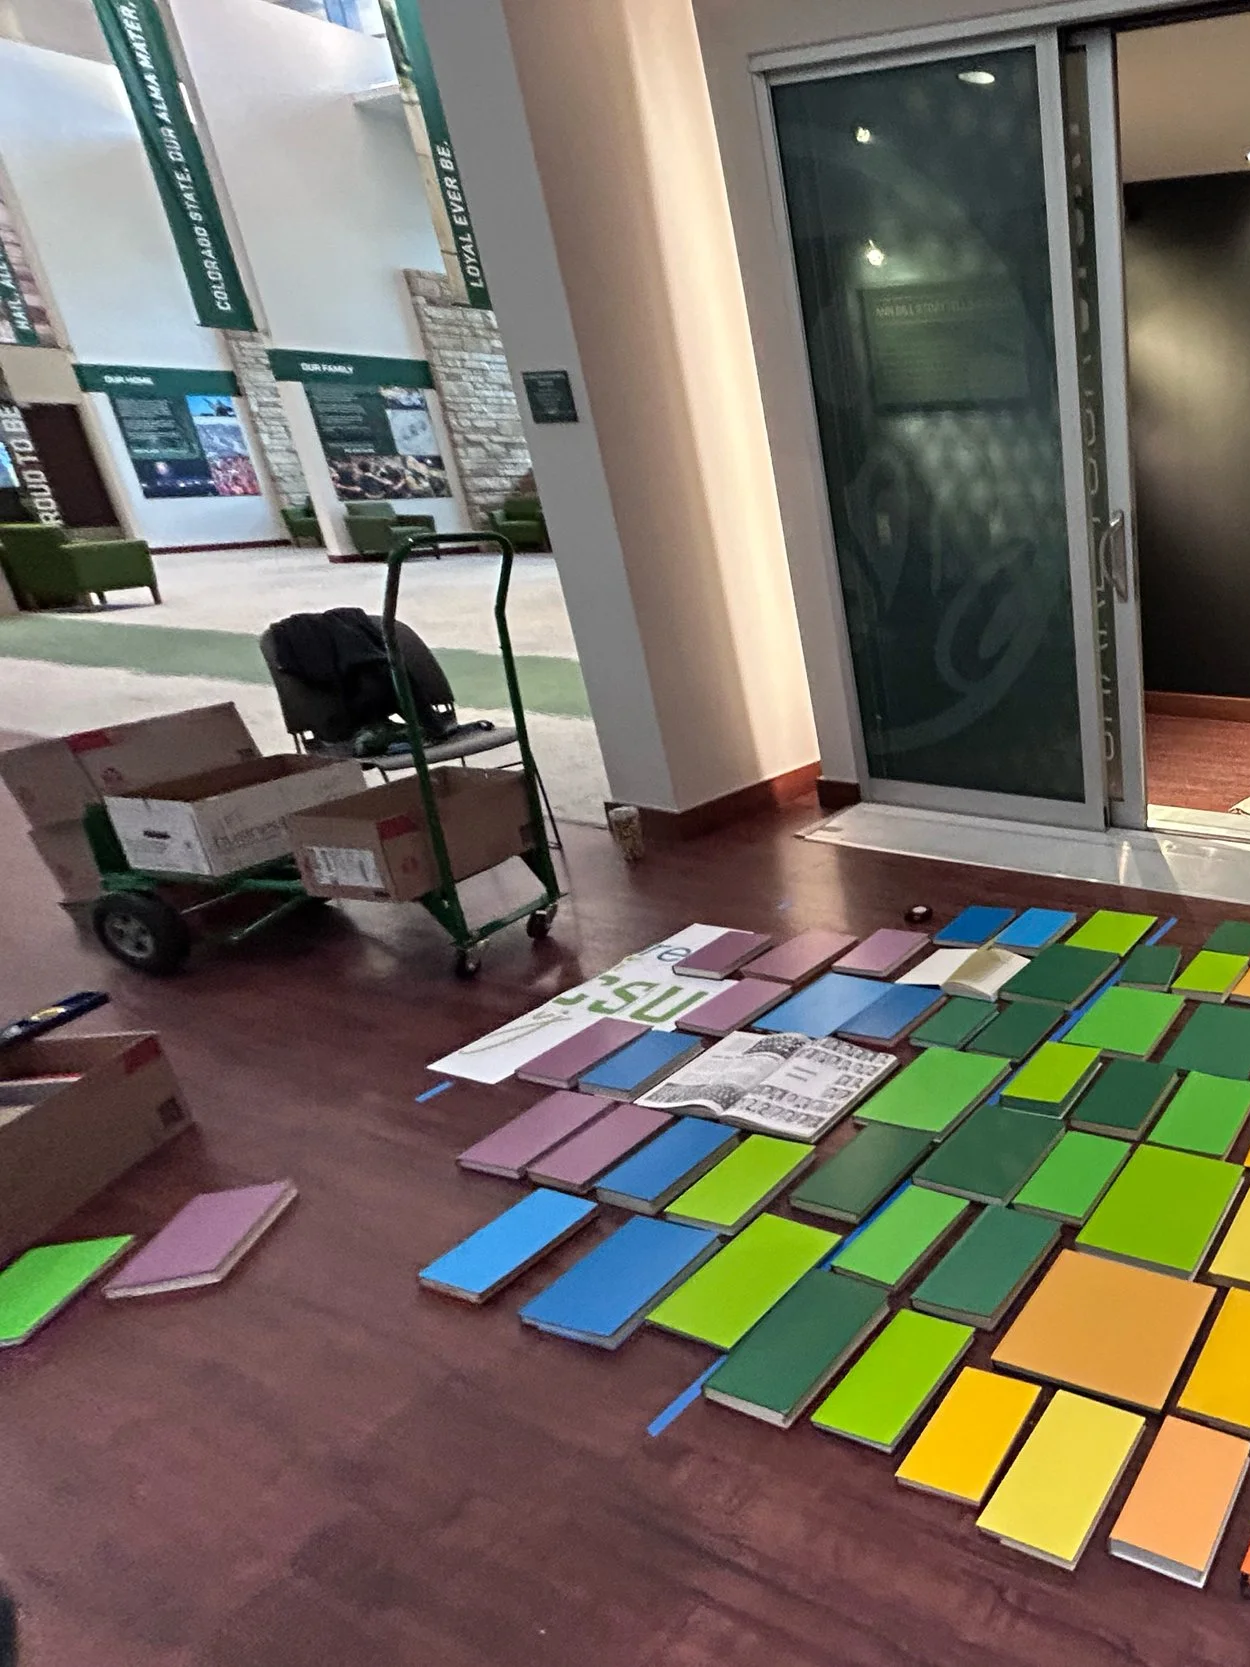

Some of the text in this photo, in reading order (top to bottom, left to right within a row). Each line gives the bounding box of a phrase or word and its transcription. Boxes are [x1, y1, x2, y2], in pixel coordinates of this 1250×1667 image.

[143, 72, 172, 124] ALMA
[160, 126, 186, 163] OUR
[443, 176, 470, 226] EVER
[193, 225, 232, 312] COLORADO
[458, 233, 485, 289] LOYAL
[103, 375, 126, 385] OUR
[300, 362, 354, 375] OUR FAMILY
[0, 404, 28, 433] BE
[9, 438, 41, 466] TO
